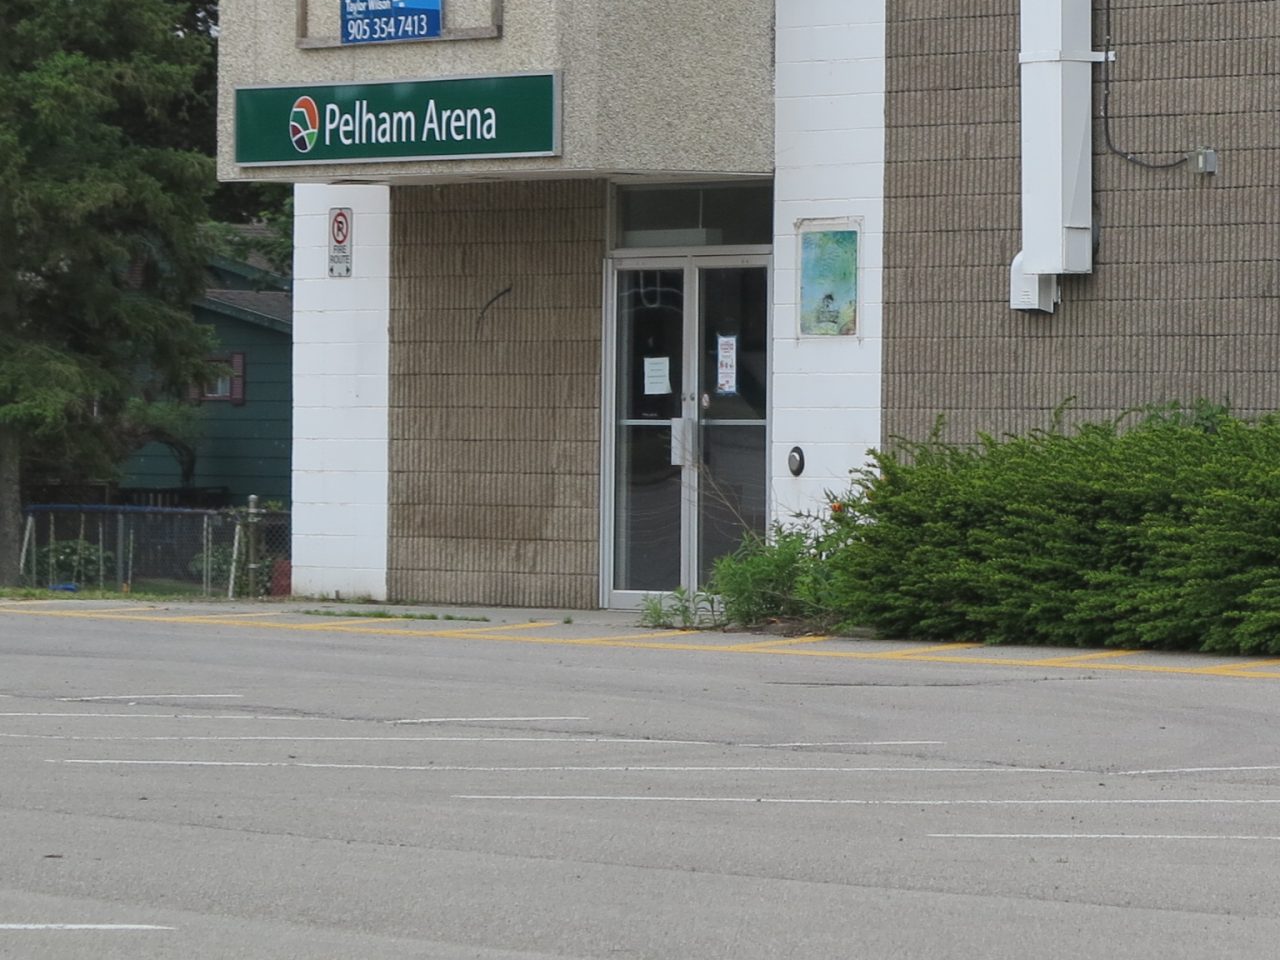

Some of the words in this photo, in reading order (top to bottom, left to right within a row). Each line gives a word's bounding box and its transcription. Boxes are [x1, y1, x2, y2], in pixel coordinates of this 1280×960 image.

[344, 0, 367, 15] Taylor
[347, 19, 370, 40] 905
[372, 17, 395, 39] 354
[397, 14, 427, 36] 7413
[325, 100, 416, 146] Pelham
[422, 99, 497, 142] Arena
[333, 244, 347, 254] FIRE
[329, 254, 350, 264] ROUTE
